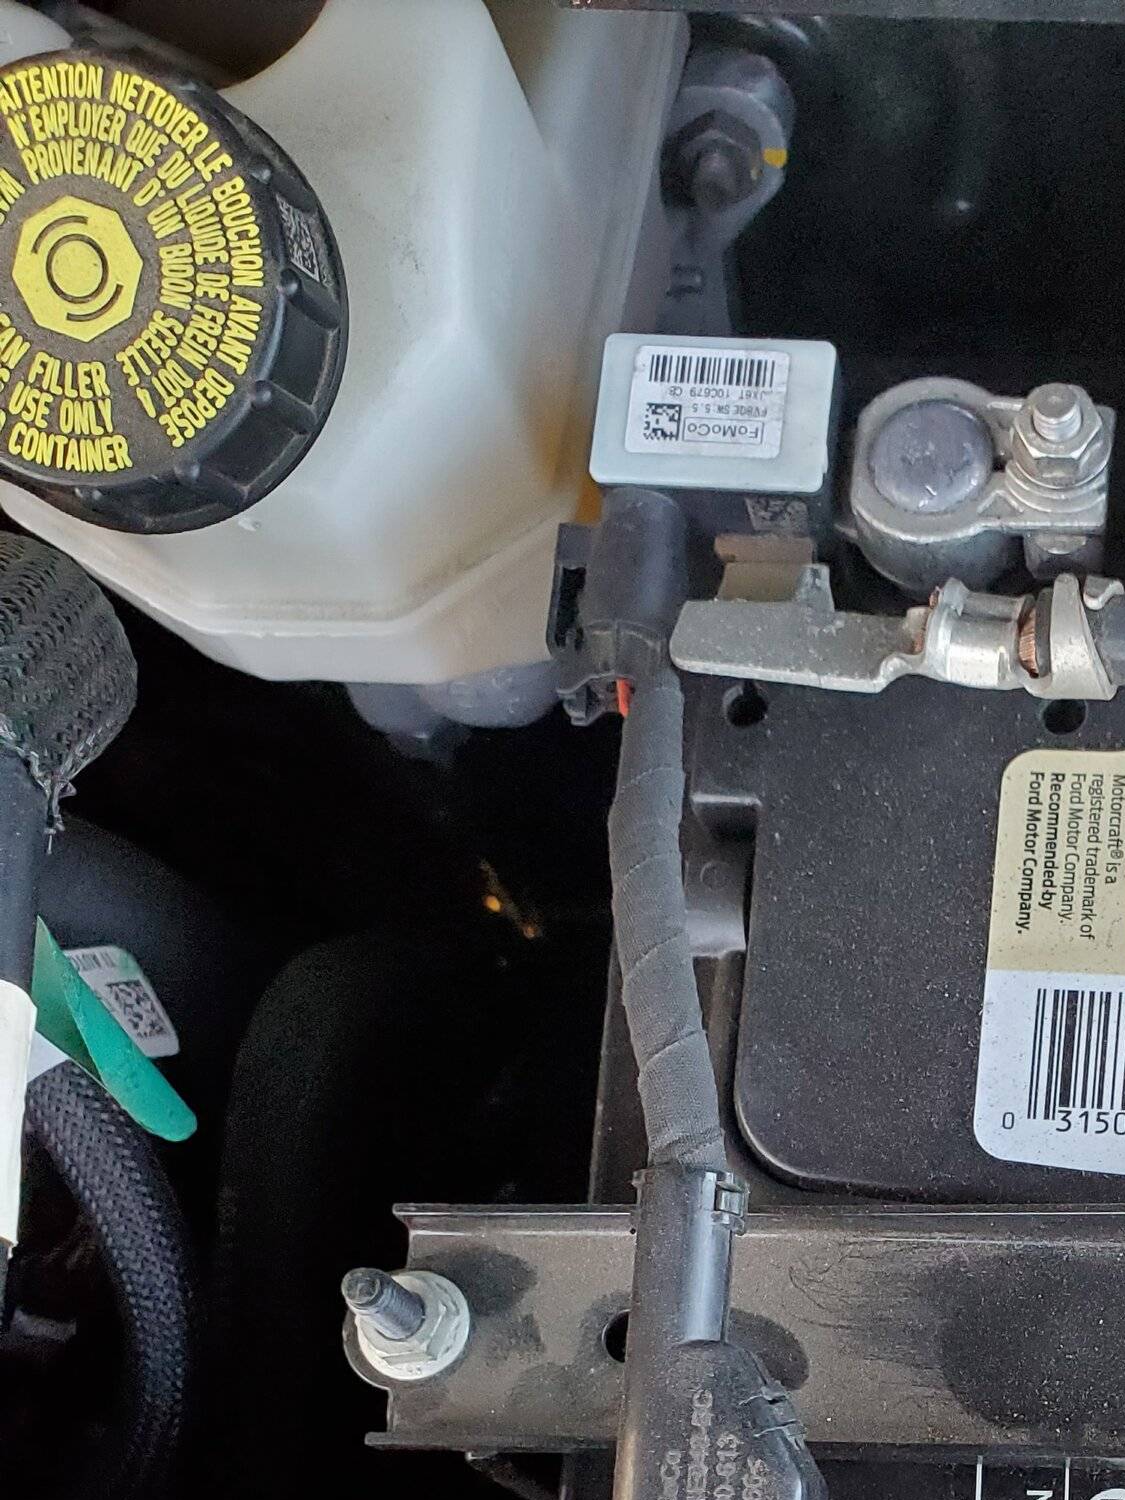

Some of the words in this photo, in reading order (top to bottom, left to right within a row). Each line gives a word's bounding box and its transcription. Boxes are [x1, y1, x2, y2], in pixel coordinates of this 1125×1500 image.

[0, 62, 104, 115] ATTENTION
[109, 70, 209, 155] NETTOYER
[21, 138, 144, 192] PROVENANT
[125, 119, 169, 168] QUE
[157, 150, 195, 189] DU
[193, 141, 233, 182] LE
[176, 182, 229, 265] LIQUIDE
[212, 176, 264, 287] BOUCHON
[159, 242, 195, 311] BIDON
[195, 272, 230, 302] DE
[116, 310, 185, 387] SCELLE
[176, 304, 226, 370] FREIN
[216, 294, 263, 376] AVANT
[28, 351, 111, 399] FILLER
[152, 358, 194, 408] DOT
[8, 381, 54, 429] USE
[59, 398, 113, 436] ONLY
[159, 367, 235, 448] DEPOSE
[687, 423, 759, 439] FoMoCo
[8, 422, 133, 473] CONTAINER
[1026, 772, 1044, 805] Ford
[1067, 773, 1086, 804] Ford
[1083, 774, 1107, 843] registered
[1023, 808, 1042, 854] Motor
[1040, 772, 1065, 888] Recommended
[1064, 807, 1083, 850] Motor
[1056, 852, 1080, 923] Company.
[1081, 847, 1102, 921] trademark
[1104, 875, 1117, 884] a
[1105, 862, 1121, 872] is
[1014, 857, 1038, 934] Company.
[1035, 889, 1056, 910] by
[1080, 924, 1097, 940] of
